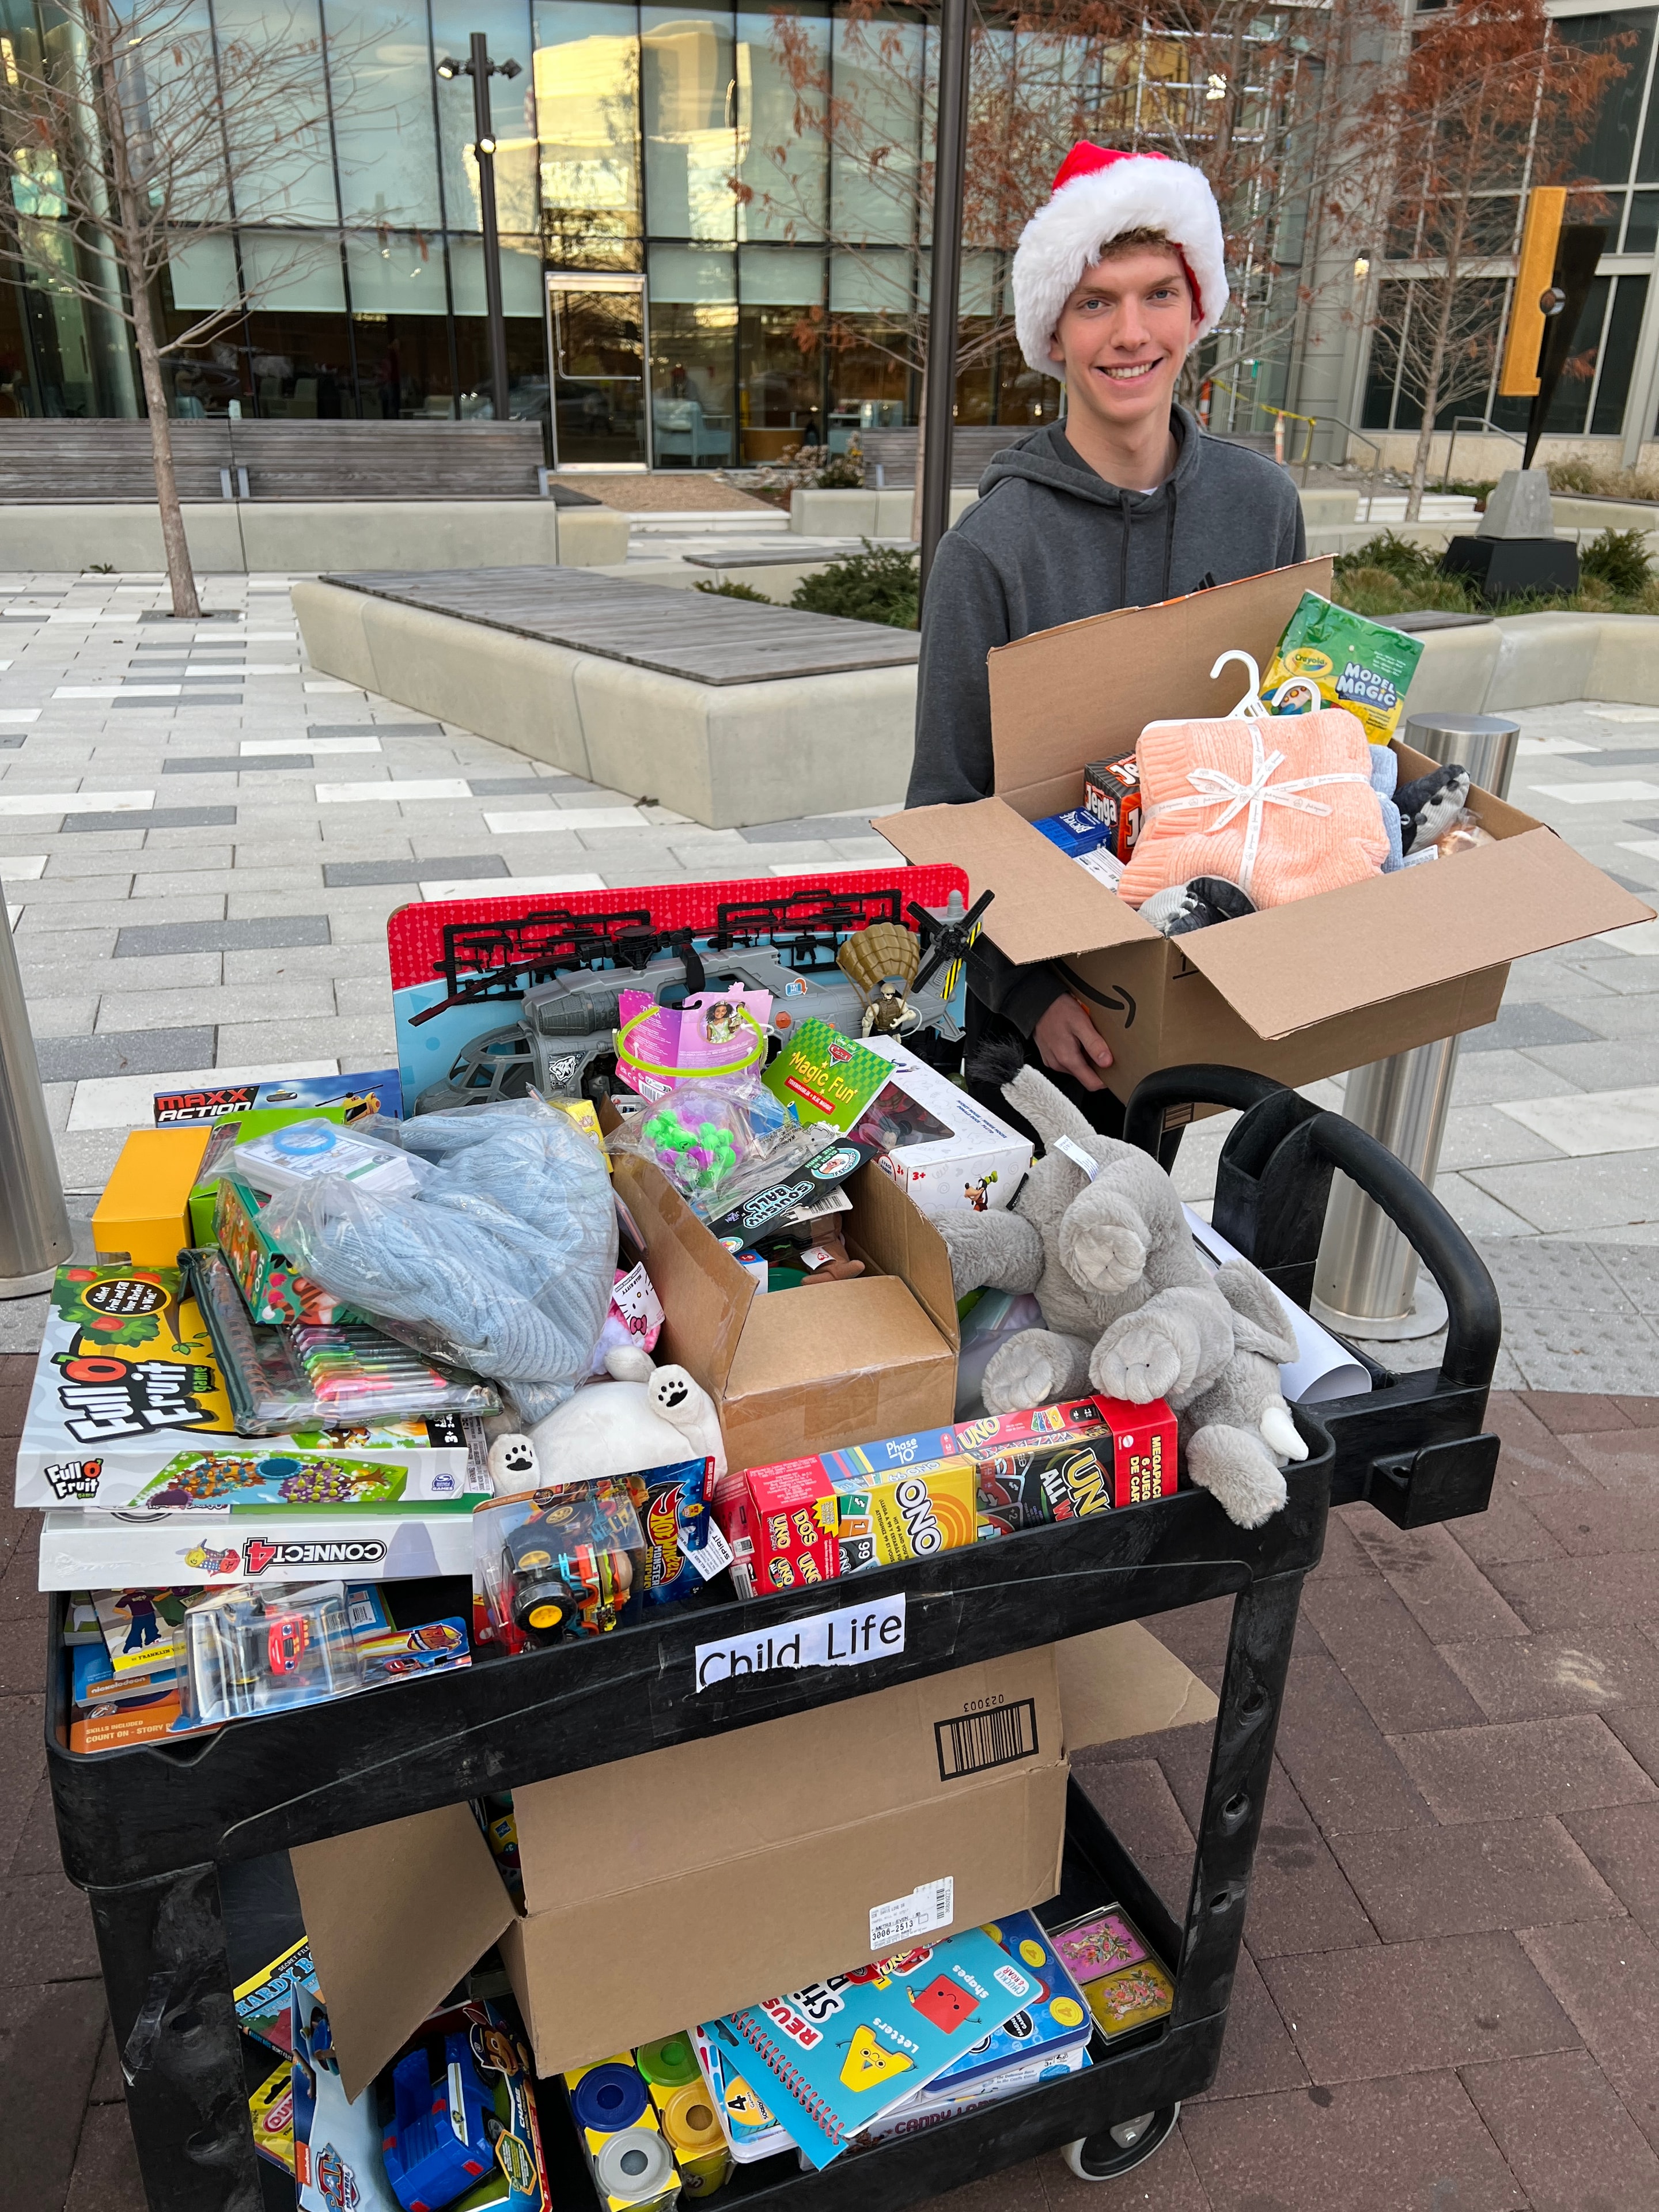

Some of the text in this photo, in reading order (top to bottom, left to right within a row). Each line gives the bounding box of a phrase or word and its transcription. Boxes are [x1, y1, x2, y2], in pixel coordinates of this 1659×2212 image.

[1296, 654, 1324, 664] Crayola
[1337, 676, 1395, 705] MAGIC
[1345, 662, 1395, 694] MODEL
[1086, 784, 1116, 827] Jenga
[831, 1046, 849, 1060] Cars
[789, 1051, 855, 1104] Magic Fun
[157, 1088, 247, 1110] MAXX
[158, 1102, 251, 1122] ACTION
[981, 1124, 994, 1134] PLUTO
[805, 1146, 835, 1169] THE DARK
[897, 1164, 904, 1175] 3+
[912, 1172, 926, 1180] 3+
[748, 1184, 810, 1226] SQUISHY
[749, 1188, 788, 1210] BALL
[622, 1283, 634, 1295] KITTY
[634, 1274, 642, 1285] HELLO
[93, 1286, 111, 1302] Collect
[105, 1282, 130, 1311] Fruit and Fill
[122, 1284, 145, 1312] Your Basket
[193, 1367, 208, 1392] game
[131, 1362, 203, 1425] Fruit
[62, 1386, 144, 1440] Full
[445, 1431, 458, 1442] 3+
[886, 1438, 917, 1455] Phase
[957, 1418, 999, 1450] UNO
[898, 1448, 914, 1464] 10
[47, 1463, 81, 1483] Full
[888, 1461, 940, 1482] ONO 99
[1130, 1456, 1139, 1502] DE CAR
[1142, 1457, 1151, 1501] 6 JUEG
[56, 1478, 97, 1497] Fruit
[1040, 1469, 1067, 1505] ALL
[1068, 1453, 1109, 1516] UN
[792, 1509, 817, 1546] DOS
[896, 1479, 941, 1555] ONO
[774, 1514, 790, 1548] UNO
[876, 1510, 887, 1536] ATTEIGNEZ
[887, 1548, 895, 1563] VOUS
[249, 1541, 382, 1571] CONNECT 4
[711, 1535, 729, 1560] SPIRIT
[858, 1541, 870, 1559] 99
[901, 1543, 910, 1559] YOU'R
[652, 1546, 662, 1586] MONSTER
[769, 1564, 778, 1574] ALL
[778, 1558, 794, 1585] UNO
[798, 1552, 821, 1584] UNO
[138, 1649, 170, 1660] FRANKLIN
[699, 1615, 902, 1686] Child Life
[91, 1677, 146, 1694] nickelodeon
[964, 1695, 1004, 1711] 023003
[86, 1720, 143, 1734] SKILLS INCLUDED
[86, 1733, 115, 1744] COUNT
[137, 1724, 164, 1734] STORY
[872, 1920, 914, 1941] 3006-2513
[278, 1956, 297, 1972] SECRET
[298, 1946, 310, 1956] FILE
[952, 1965, 989, 1998] shapes
[996, 1970, 1025, 1994] CHUCKLE
[1003, 1967, 1020, 1982] ROAR
[236, 1967, 300, 2016] HARDY
[793, 1983, 839, 2018] Sti
[763, 1997, 819, 2046] REUS
[873, 2017, 920, 2054] Letters
[269, 2099, 291, 2126] DUN
[515, 2087, 525, 2128] CHASE
[728, 2095, 746, 2111] 4
[895, 2109, 951, 2134] CANDY
[323, 2143, 342, 2212] PAW
